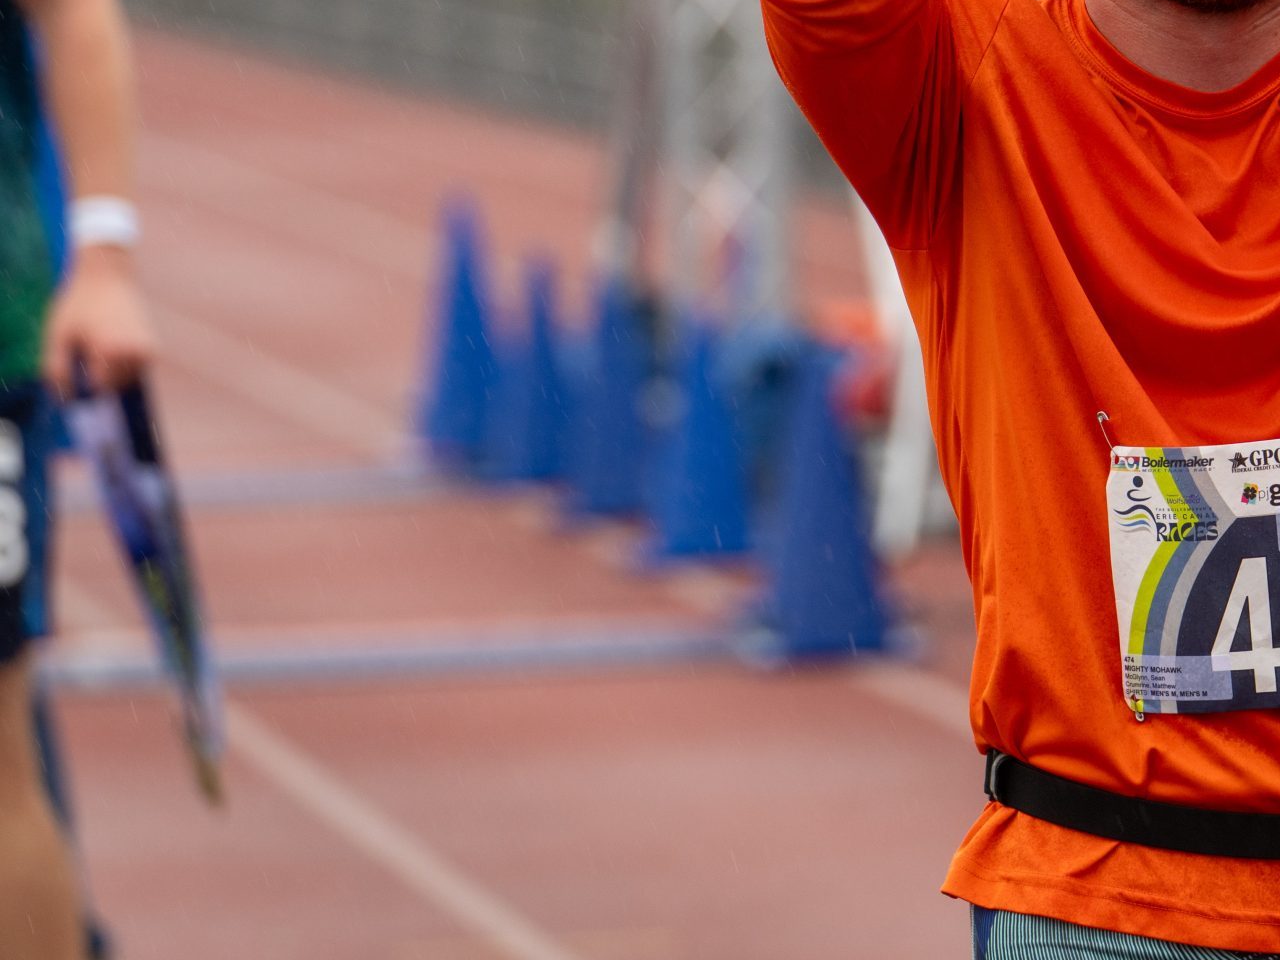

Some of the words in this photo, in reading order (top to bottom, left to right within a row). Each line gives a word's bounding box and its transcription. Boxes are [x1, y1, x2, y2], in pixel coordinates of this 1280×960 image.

[1142, 455, 1215, 469] Boilermaker
[1182, 512, 1218, 520] CANAL
[1156, 521, 1219, 542] RACES
[1124, 664, 1149, 673] MIGHTY
[1150, 666, 1183, 674] MOHAWK
